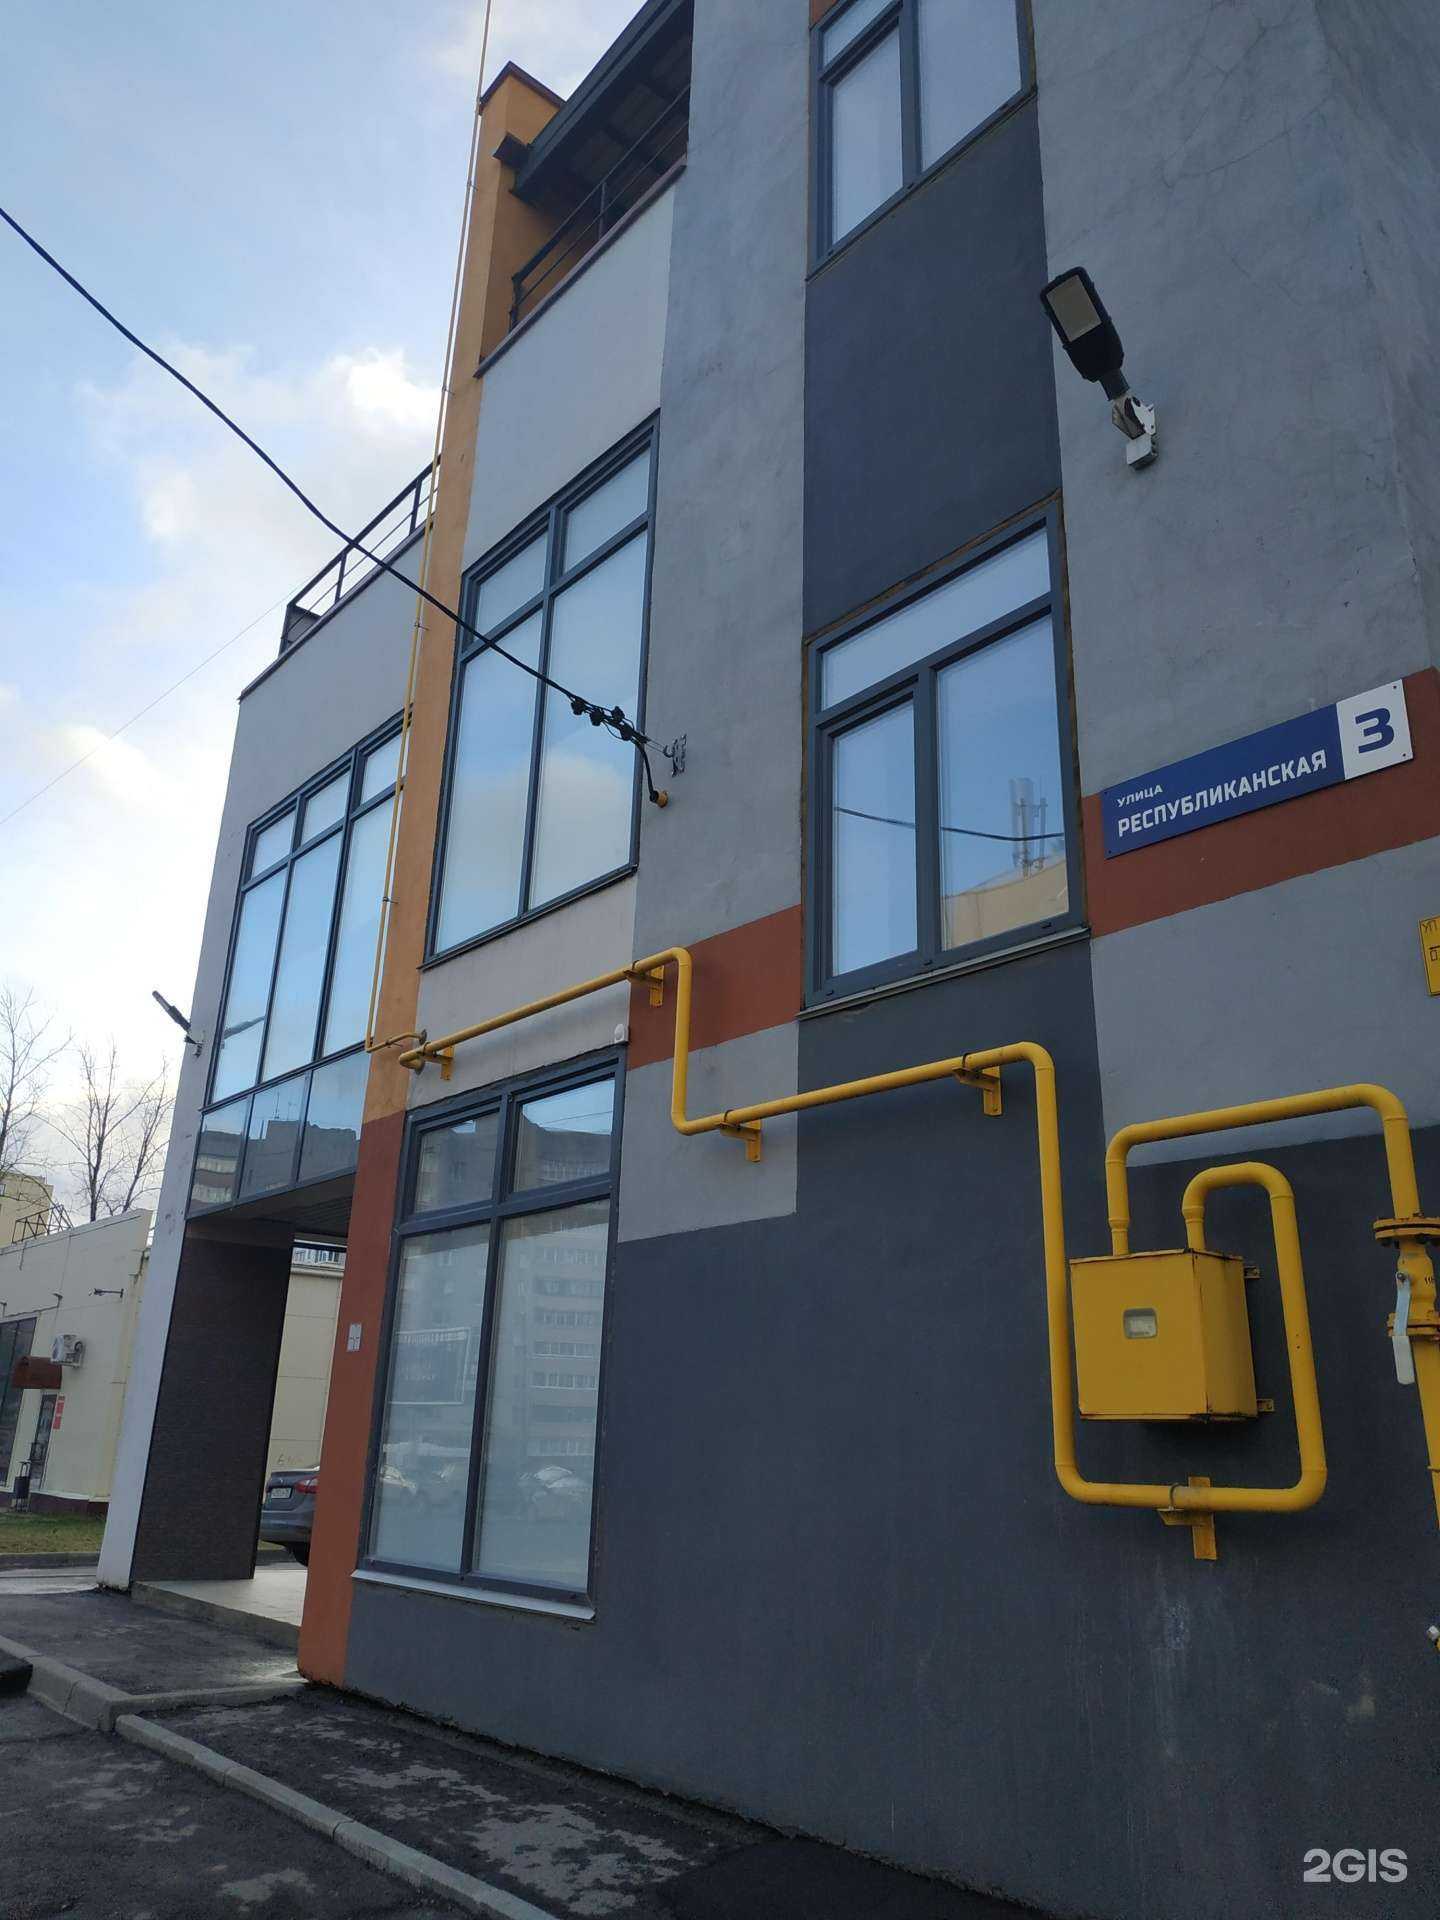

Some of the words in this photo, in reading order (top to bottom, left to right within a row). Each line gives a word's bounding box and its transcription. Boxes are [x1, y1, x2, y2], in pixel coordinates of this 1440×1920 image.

[1355, 707, 1395, 754] 3
[1116, 784, 1163, 808] УЛИЦА
[1117, 749, 1327, 838] РЕСПУБЛИКАНСКАЯ
